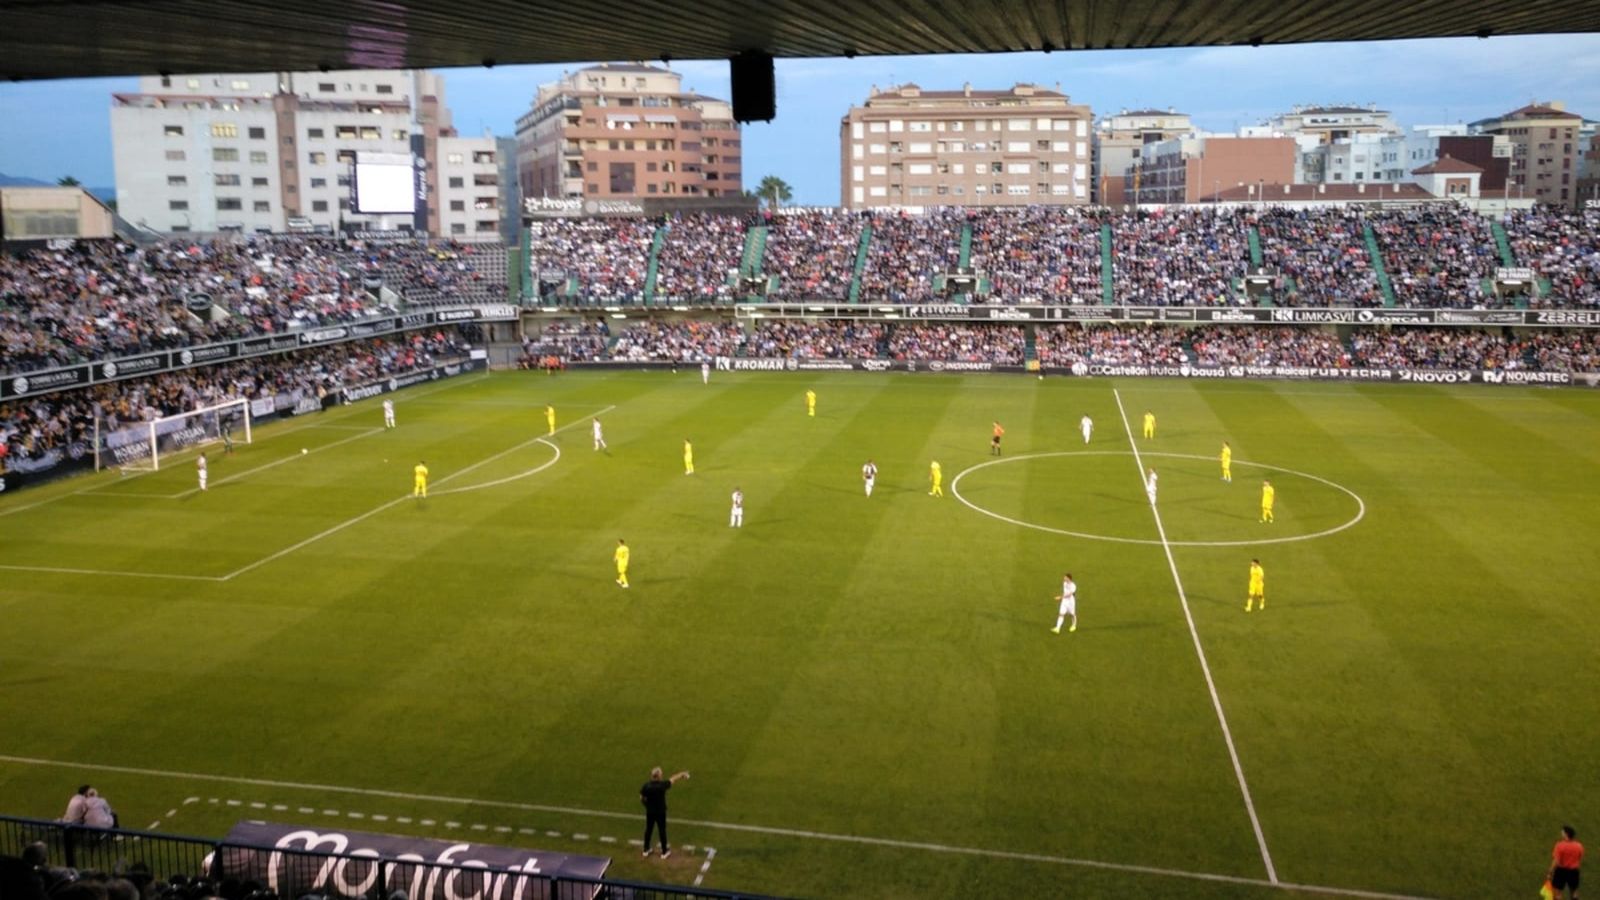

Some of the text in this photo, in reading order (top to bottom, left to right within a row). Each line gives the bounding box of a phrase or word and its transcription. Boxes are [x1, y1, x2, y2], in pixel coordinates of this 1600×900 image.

[1295, 311, 1351, 321] LIMKASVI
[735, 359, 784, 370] KROMAN
[1102, 365, 1148, 376] Castellón
[1413, 373, 1457, 383] NOVO
[1506, 371, 1568, 382] NOVASTEC
